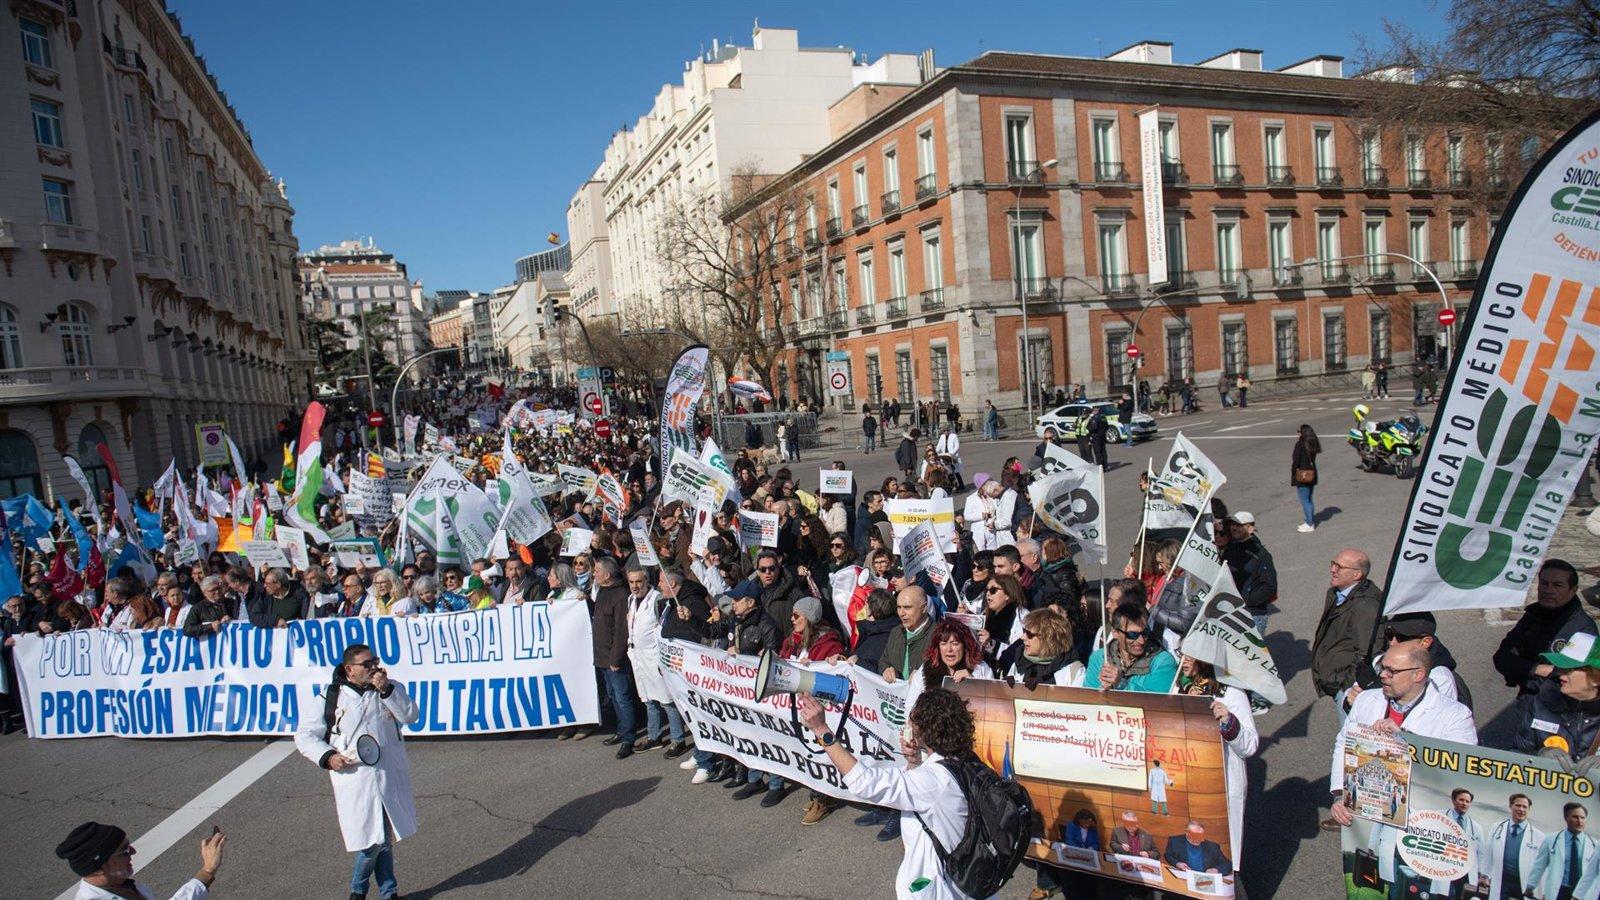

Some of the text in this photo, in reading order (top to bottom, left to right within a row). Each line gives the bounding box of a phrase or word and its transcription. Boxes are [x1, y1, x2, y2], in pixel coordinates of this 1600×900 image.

[602, 369, 611, 382] P
[1403, 281, 1524, 564] SINDICATO MÉDICO
[668, 479, 696, 496] CASTILLA
[1504, 490, 1564, 584] Castilla
[1560, 429, 1592, 460] La
[40, 630, 92, 678] POR
[101, 629, 136, 677] UN
[405, 608, 504, 665] PARA
[512, 603, 553, 661] LA
[700, 654, 717, 669] SIN
[685, 671, 700, 686] NO
[701, 675, 721, 694] HAY
[40, 678, 174, 735] PROFESIÓN
[184, 672, 299, 735] MÉDICA
[688, 690, 756, 725] JAQUE
[859, 730, 896, 762] LA
[1022, 708, 1088, 724] Acuerdo para
[1097, 711, 1114, 724] LA
[698, 720, 791, 766] SANIDAD
[1022, 732, 1061, 745] Estatuto
[1120, 729, 1134, 741] DE
[1423, 746, 1460, 773] UN
[1465, 753, 1595, 799] ESTATUTO
[1419, 811, 1463, 839] PROFESIÓN
[1401, 834, 1468, 861] CESM
[1441, 832, 1469, 850] MÉDICO
[1411, 858, 1459, 878] DEFIÉNDELA
[1439, 855, 1465, 868] Mancha
